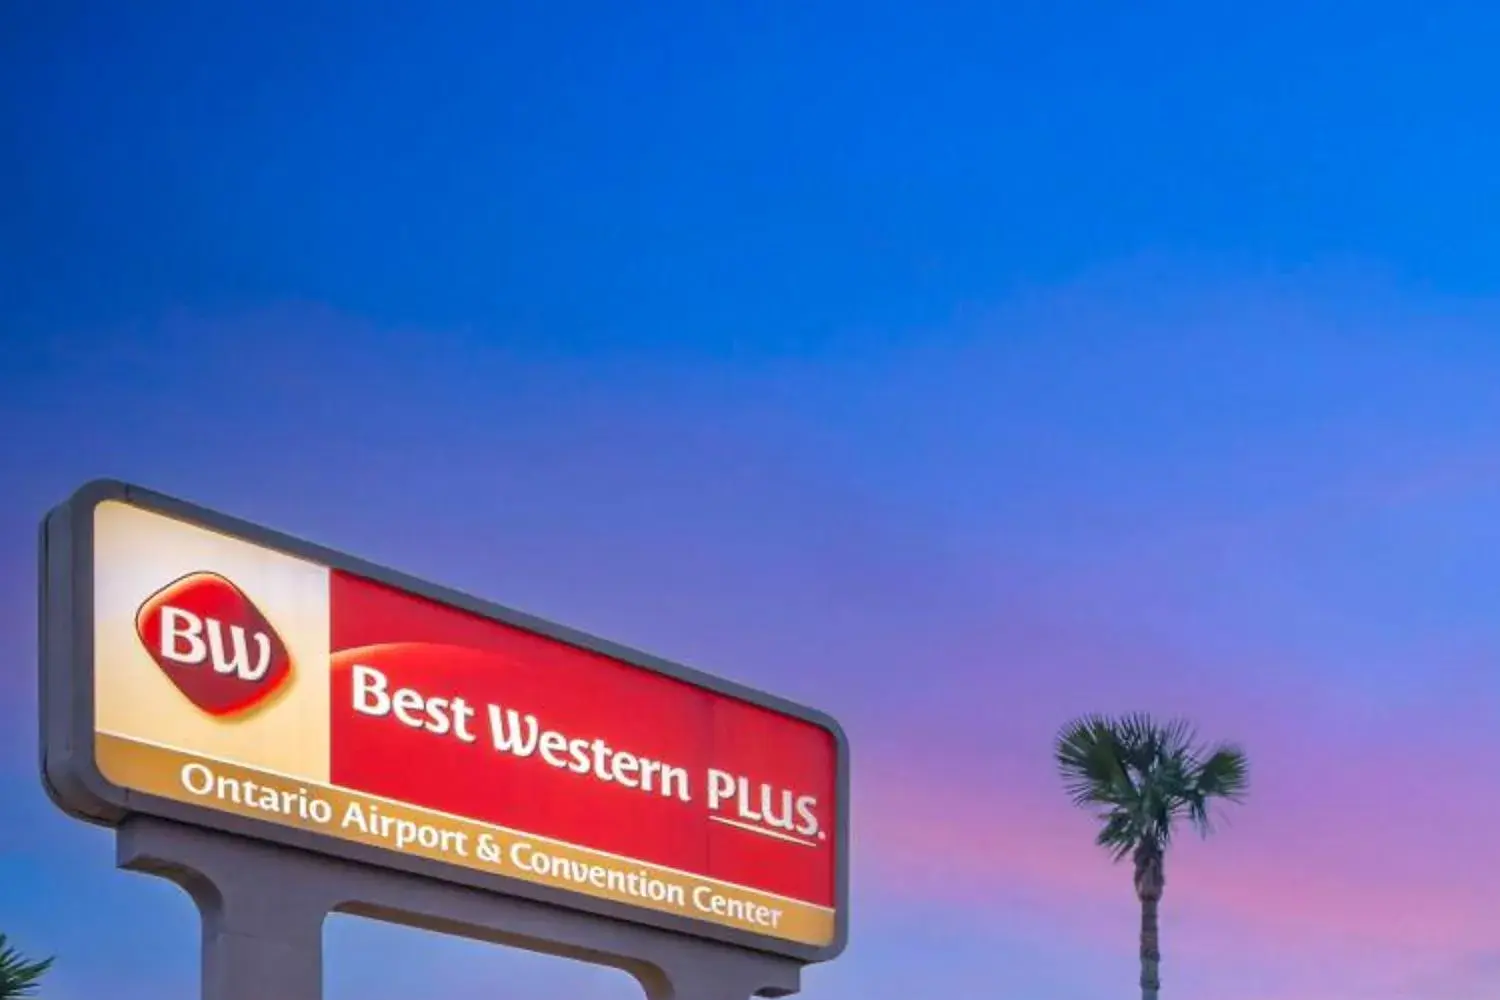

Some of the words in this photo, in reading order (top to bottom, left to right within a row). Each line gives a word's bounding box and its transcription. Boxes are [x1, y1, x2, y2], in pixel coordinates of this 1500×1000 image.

[160, 605, 271, 681] BW
[352, 664, 476, 742] Best
[487, 703, 692, 801] Western
[180, 762, 332, 823] Ontario
[341, 801, 469, 857] Airport
[475, 833, 502, 863] &
[509, 842, 685, 907] Convention
[692, 886, 784, 929] Center
